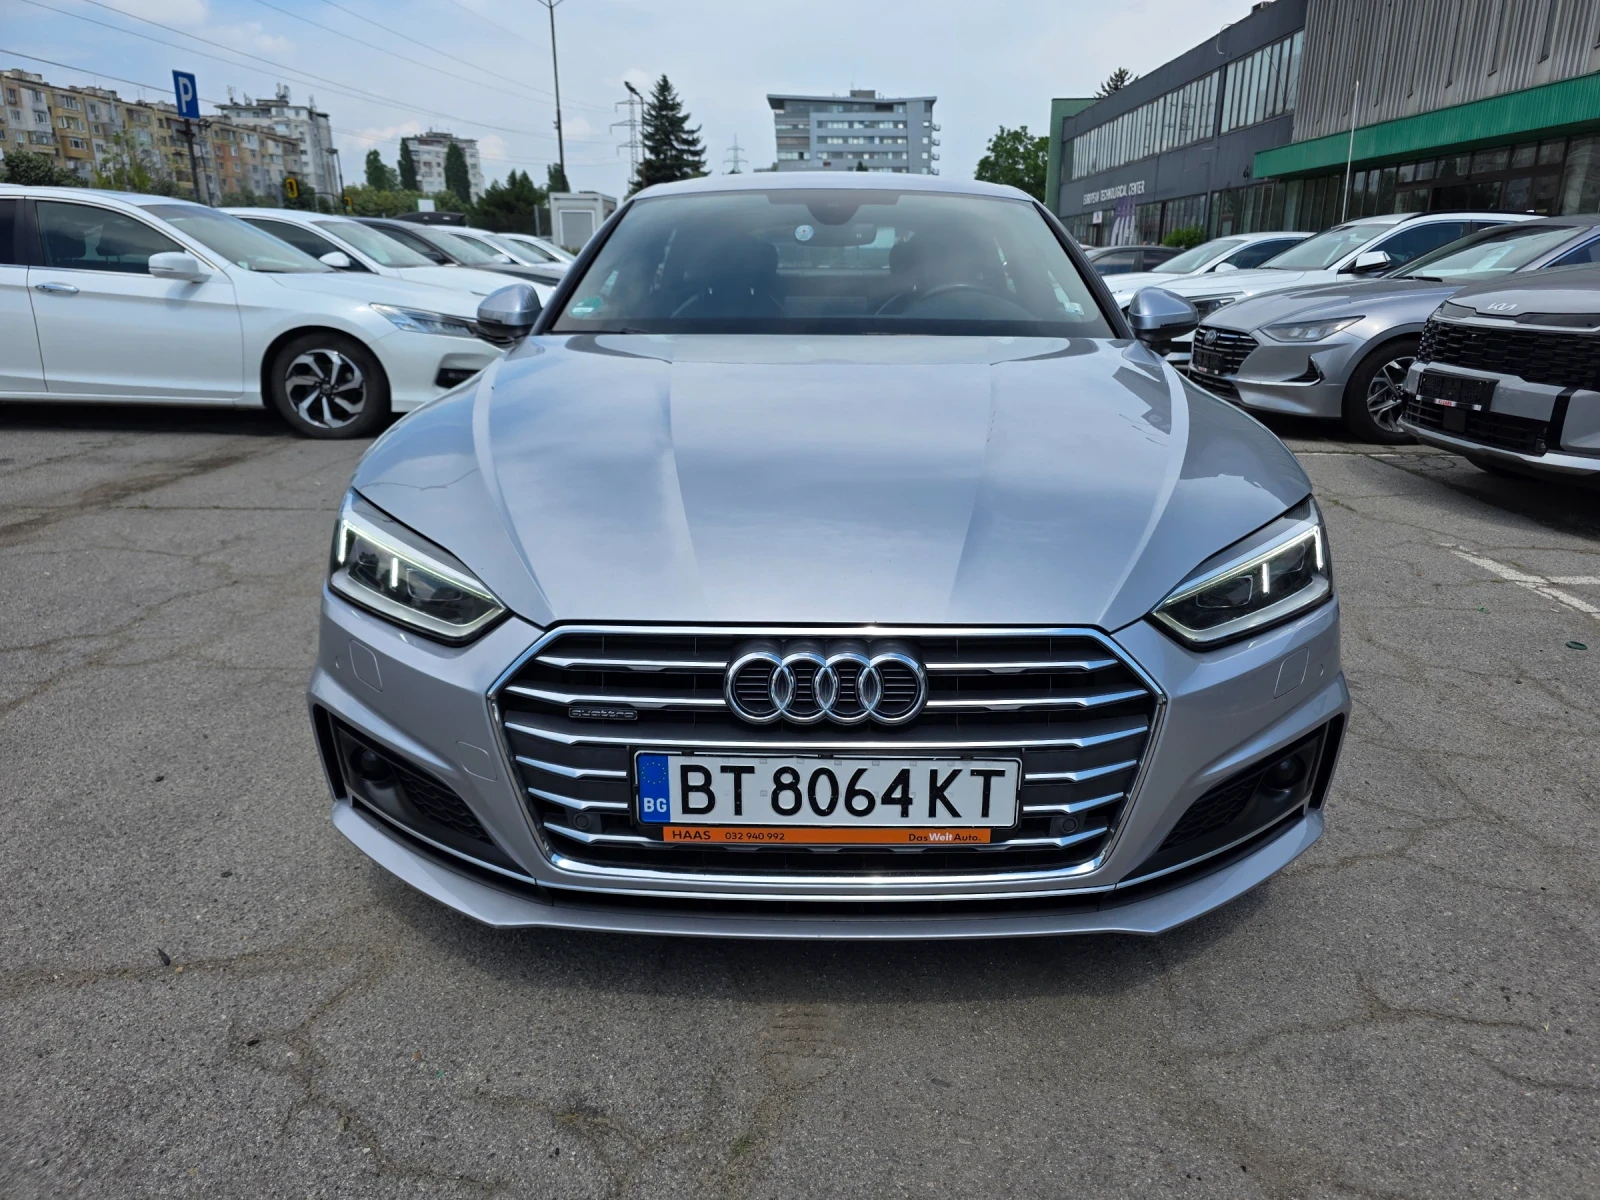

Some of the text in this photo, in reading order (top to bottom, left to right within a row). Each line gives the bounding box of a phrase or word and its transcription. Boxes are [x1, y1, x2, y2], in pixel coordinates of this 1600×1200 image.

[178, 76, 193, 113] P
[1128, 180, 1145, 196] CENTER
[1486, 302, 1518, 311] KIA
[571, 709, 635, 718] quattro
[680, 764, 1006, 818] BT 8064 KT
[643, 797, 667, 813] BG
[672, 829, 785, 841] HAAS 032 940 992
